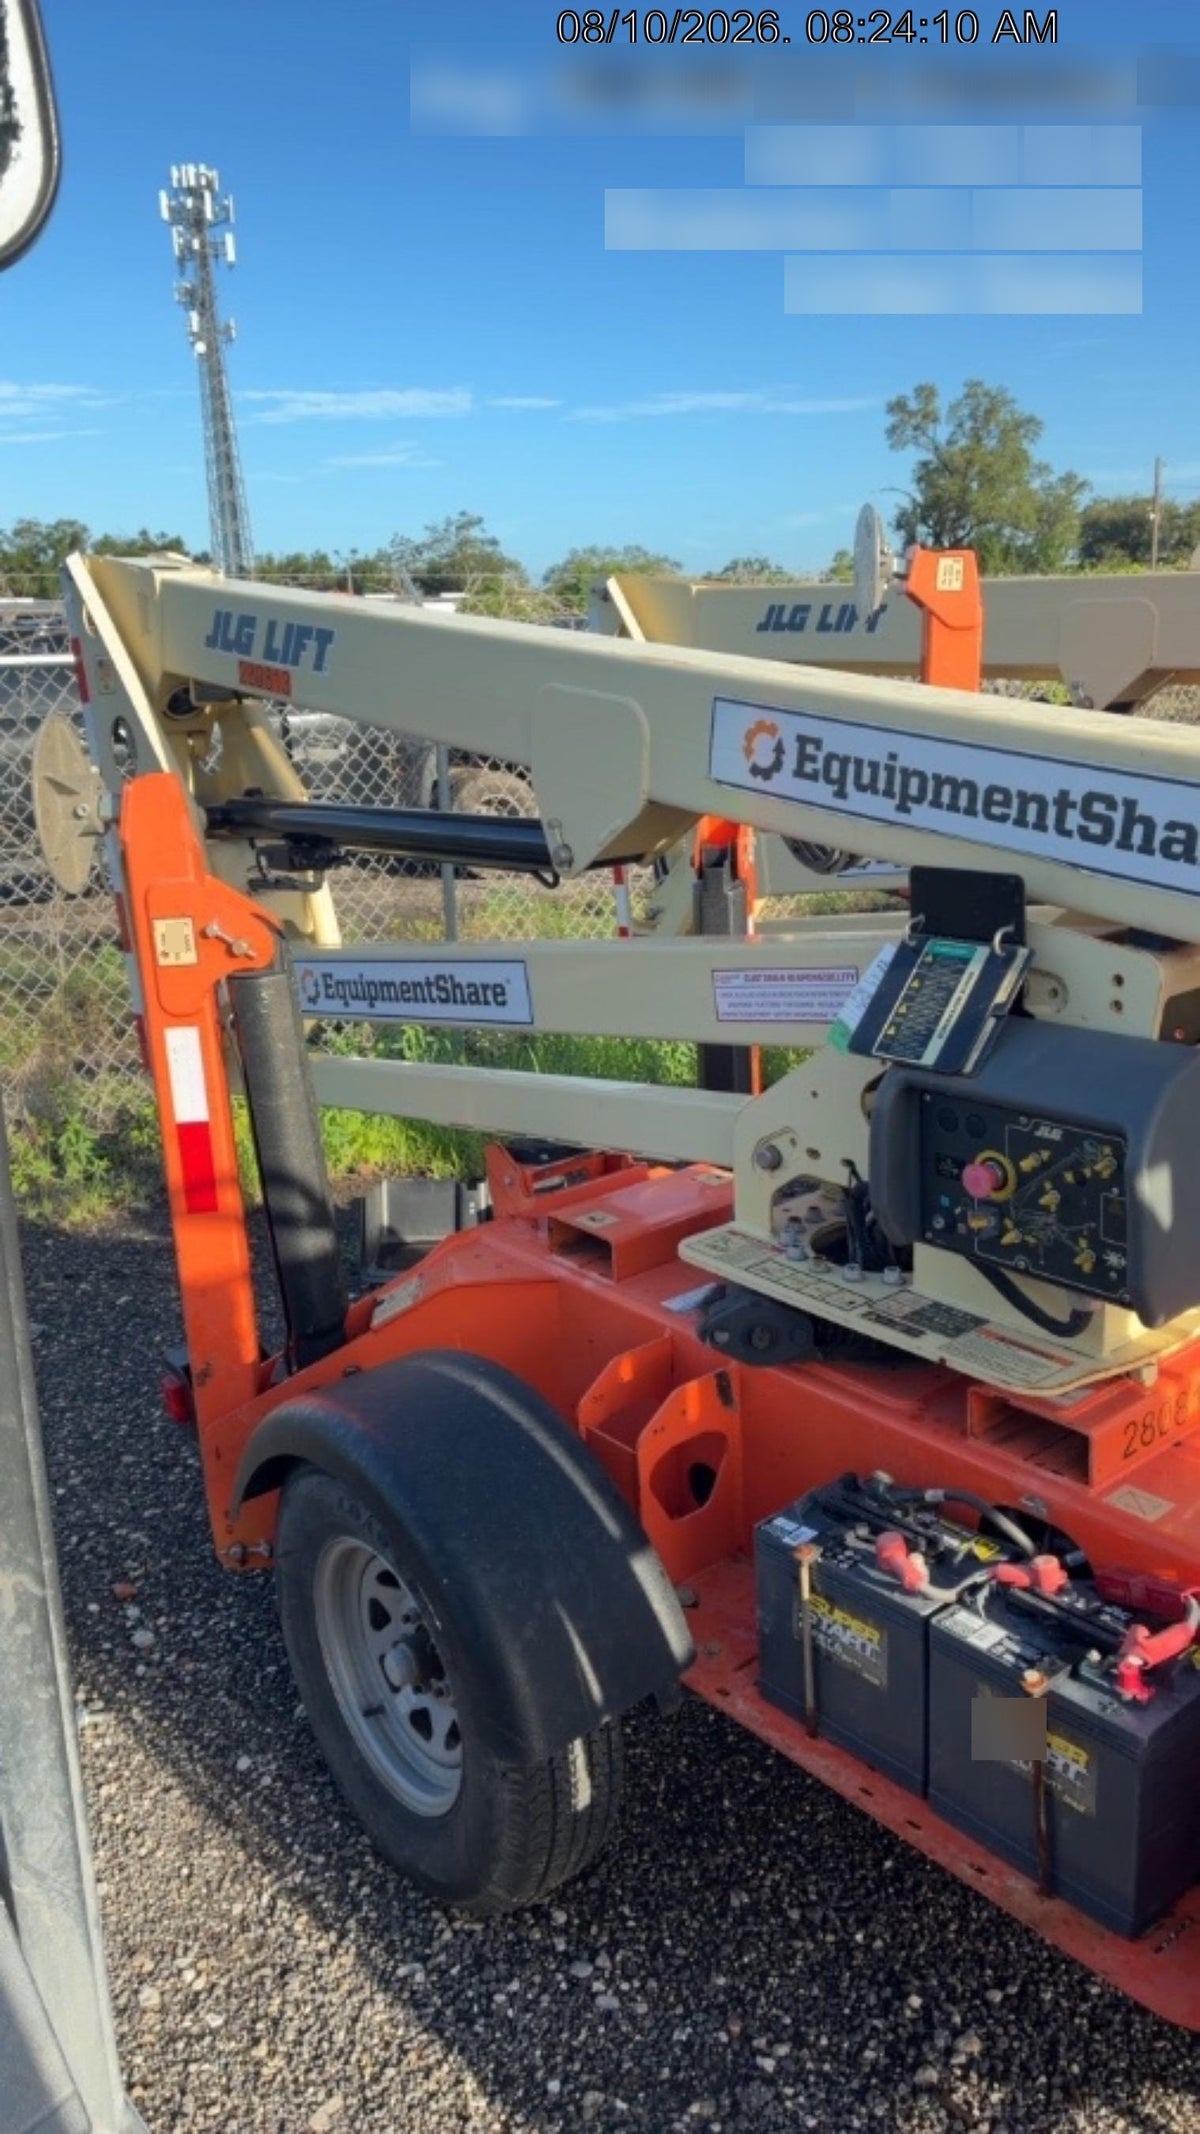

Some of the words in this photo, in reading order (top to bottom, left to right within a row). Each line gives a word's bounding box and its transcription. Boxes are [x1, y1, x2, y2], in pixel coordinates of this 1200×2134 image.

[205, 610, 257, 657] JLG
[263, 619, 336, 672] LIFT
[756, 604, 812, 632] JLG
[792, 734, 1199, 866] EquipmentSha
[322, 972, 507, 1009] EquipmentShare
[1122, 1384, 1200, 1460] 2808
